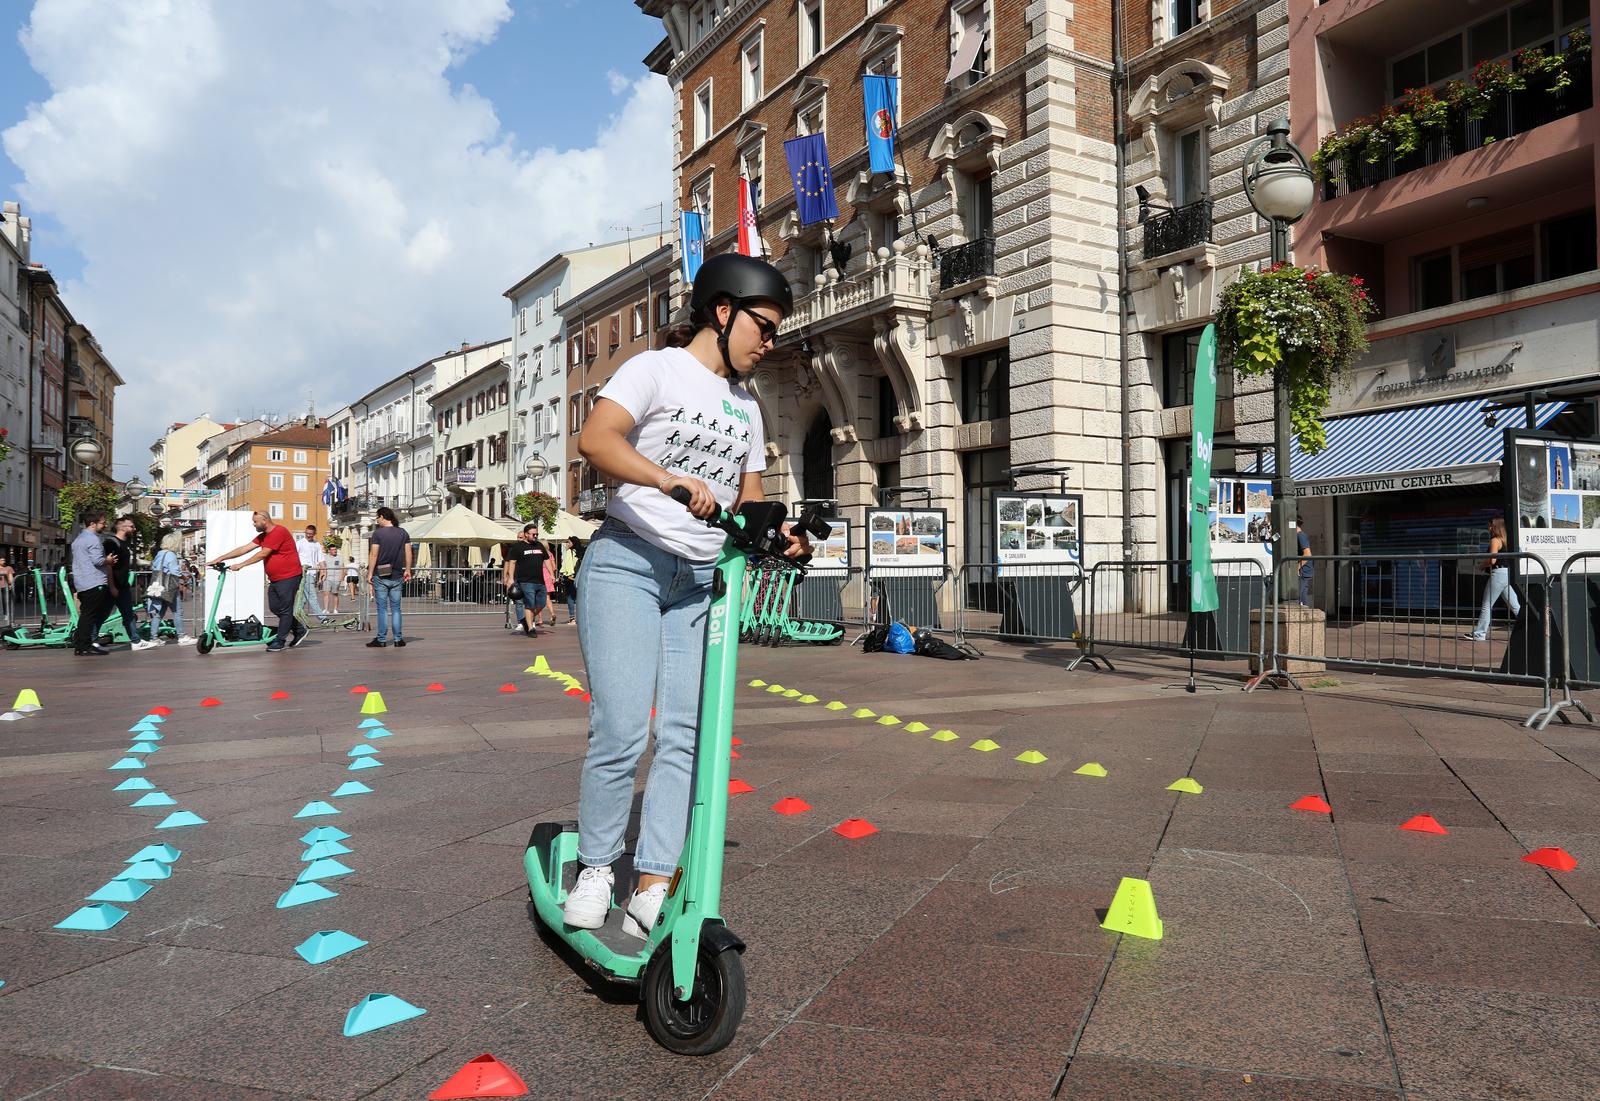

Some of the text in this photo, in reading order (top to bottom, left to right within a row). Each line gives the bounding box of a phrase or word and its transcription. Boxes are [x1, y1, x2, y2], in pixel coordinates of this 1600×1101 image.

[1376, 363, 1515, 393] TOURIST INFORMATION
[1311, 478, 1395, 496] INFORMATIVNI
[1401, 473, 1453, 488] CENTAR
[709, 604, 725, 646] Bolt
